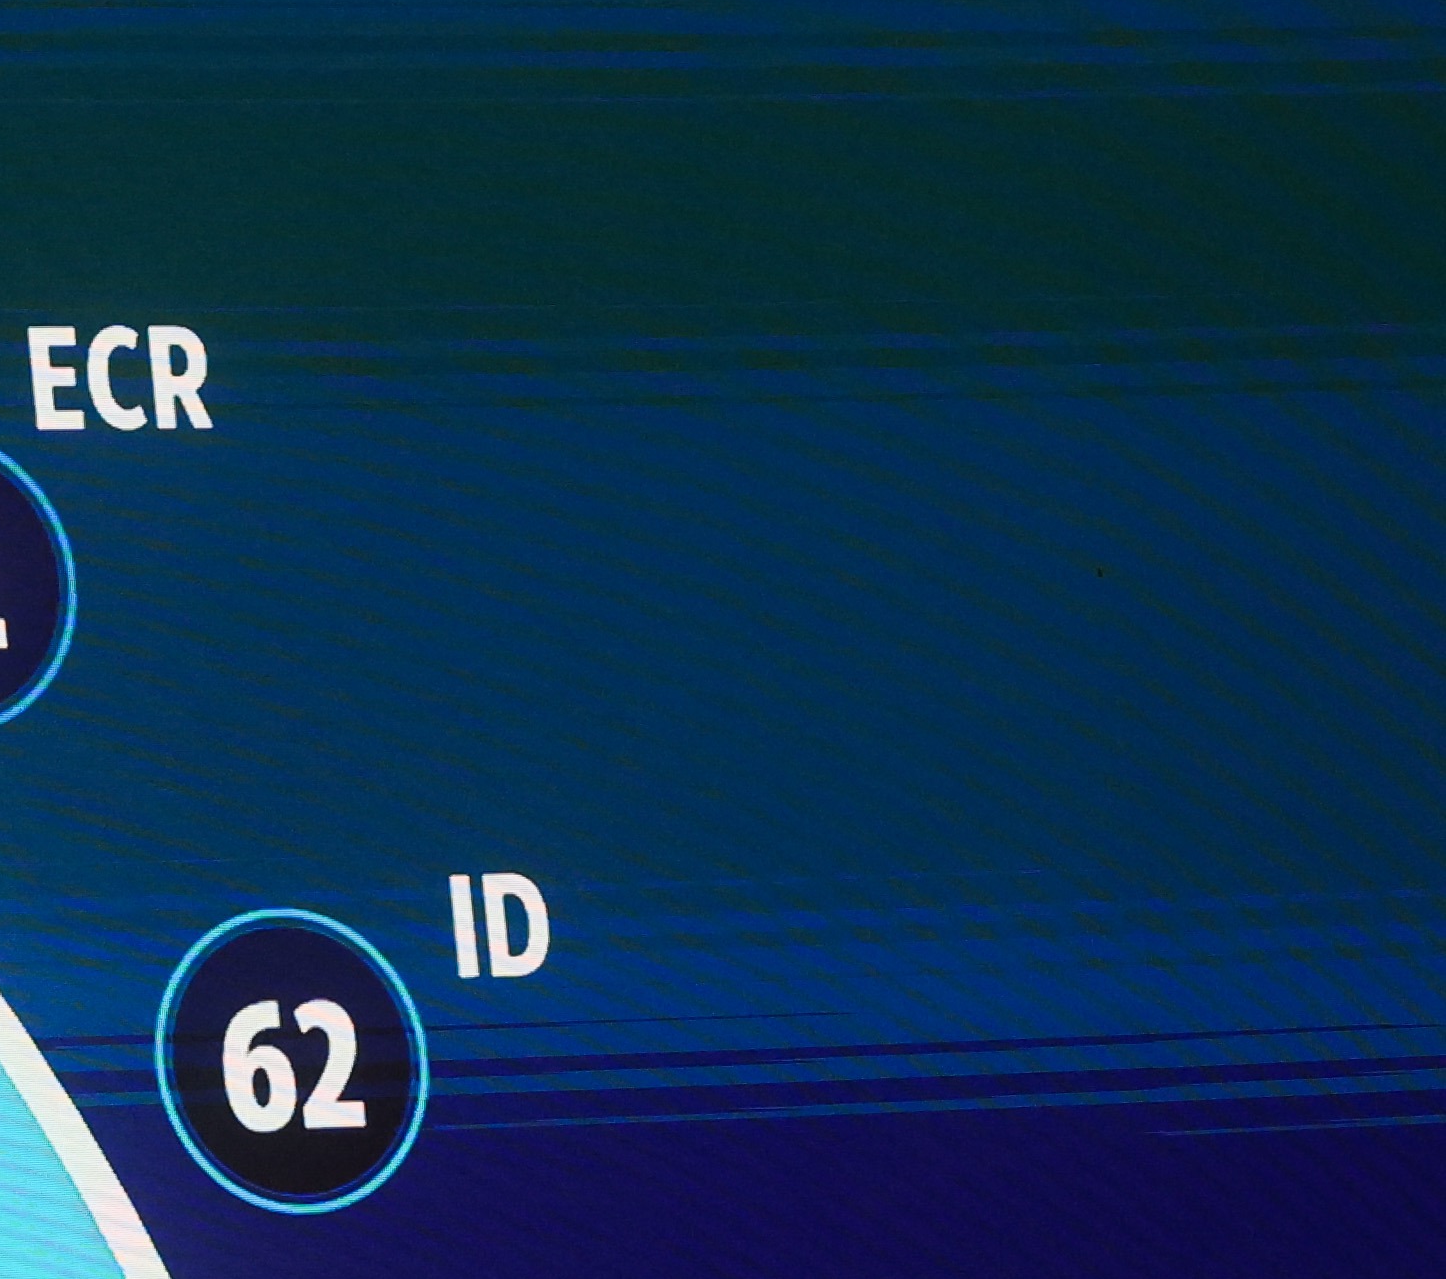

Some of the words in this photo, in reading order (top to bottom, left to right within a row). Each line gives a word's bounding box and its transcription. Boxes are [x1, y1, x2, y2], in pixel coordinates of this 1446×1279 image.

[29, 326, 211, 429] ECR
[451, 874, 549, 977] ID
[223, 1000, 365, 1132] 62
